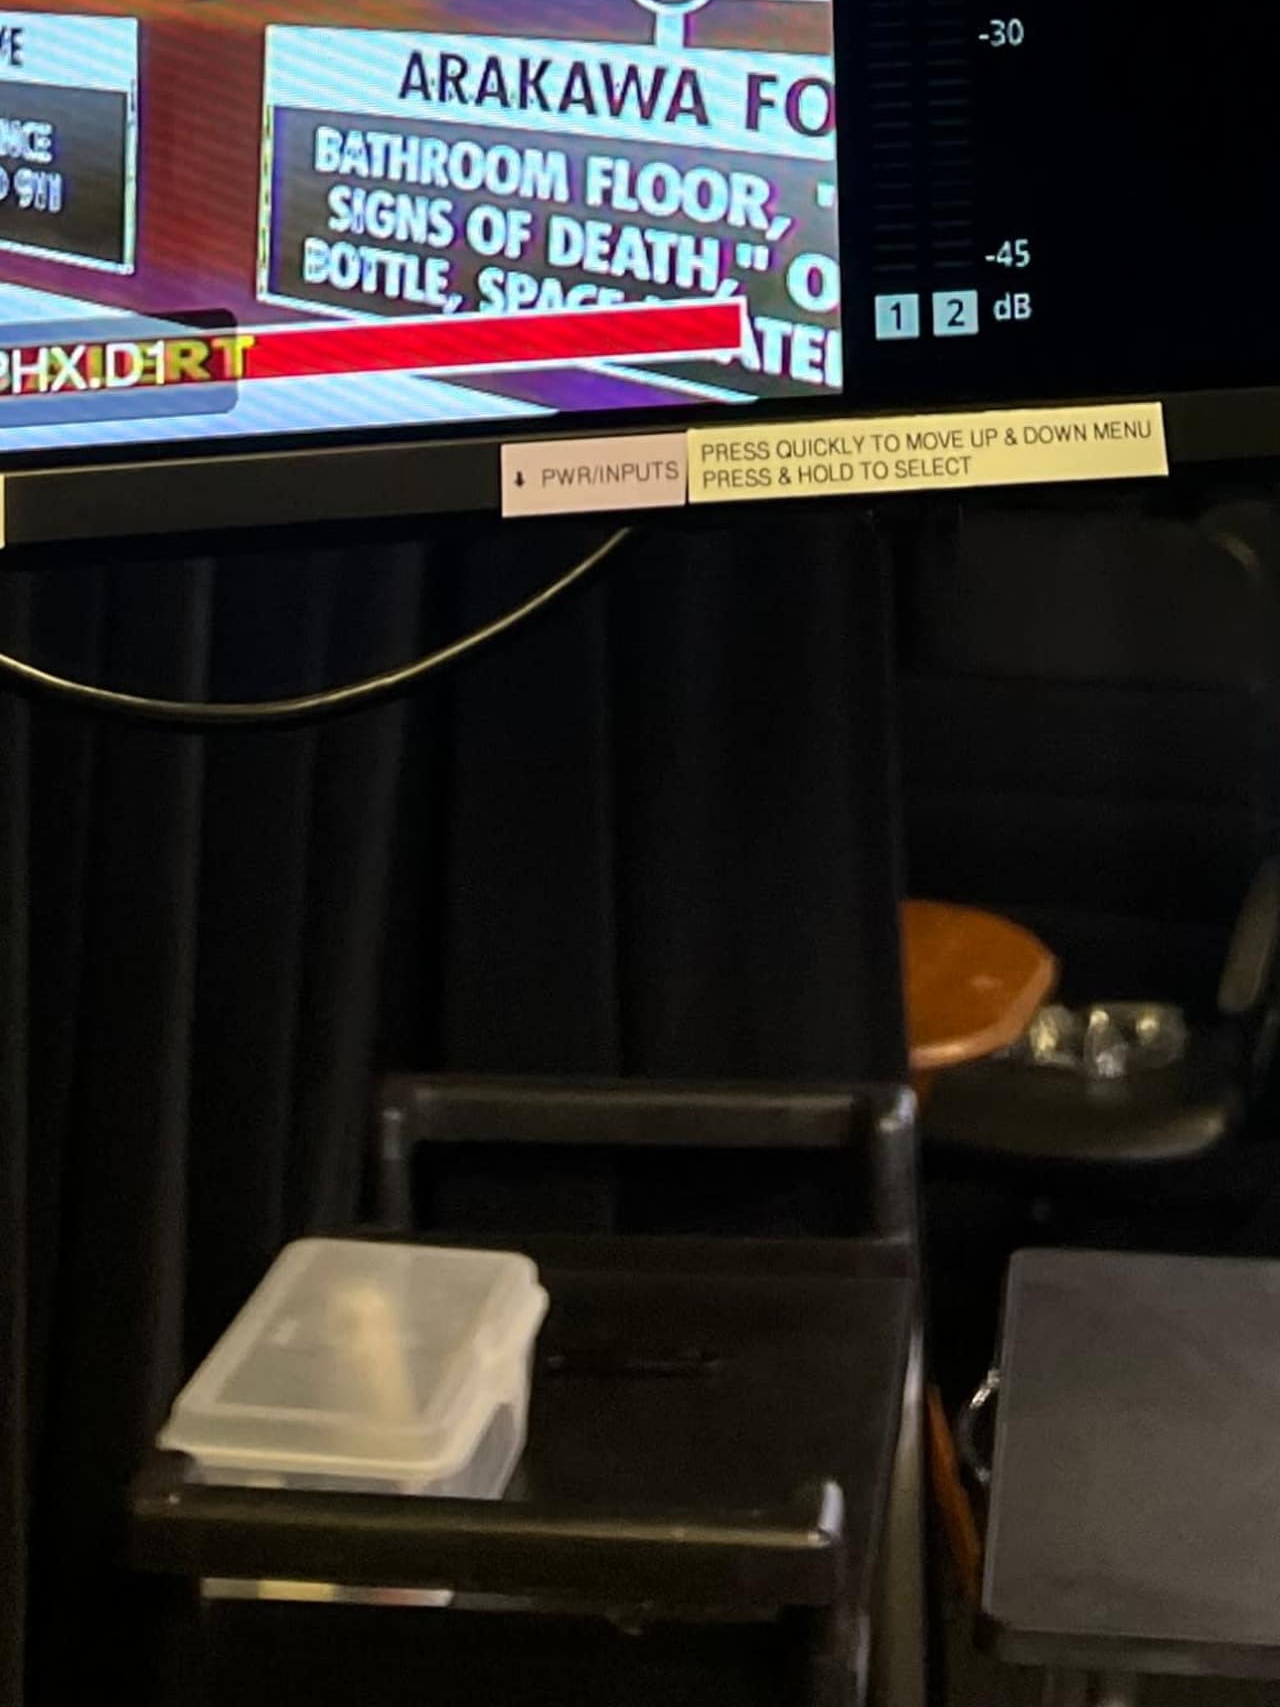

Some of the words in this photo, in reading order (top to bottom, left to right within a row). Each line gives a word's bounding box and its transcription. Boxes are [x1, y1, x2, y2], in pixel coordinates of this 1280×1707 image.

[978, 19, 1025, 46] -30
[398, 49, 710, 127] ARAKAWA
[314, 125, 570, 204] BATHROOM
[586, 155, 793, 242] FLOOR,
[328, 185, 454, 249] SIGNS
[466, 205, 533, 260] OF
[984, 239, 1031, 268] -45
[304, 237, 463, 315] BOTTLE,
[889, 302, 903, 330] 1
[946, 300, 965, 327] 2
[992, 292, 1032, 321] dB
[701, 441, 770, 463] PRESS
[776, 436, 865, 460] QUICKLY
[870, 433, 901, 454] TO
[906, 430, 964, 452] MOVE
[970, 428, 999, 448] UP
[1003, 426, 1019, 446] &
[1024, 422, 1088, 445] DOWN
[1093, 419, 1152, 441] MENU
[541, 460, 680, 488] PWR/INPUTS
[702, 467, 772, 490] PRESS
[778, 466, 792, 485] &
[797, 463, 854, 485] HOLD
[859, 460, 890, 481] TO
[895, 455, 973, 479] SELECT
